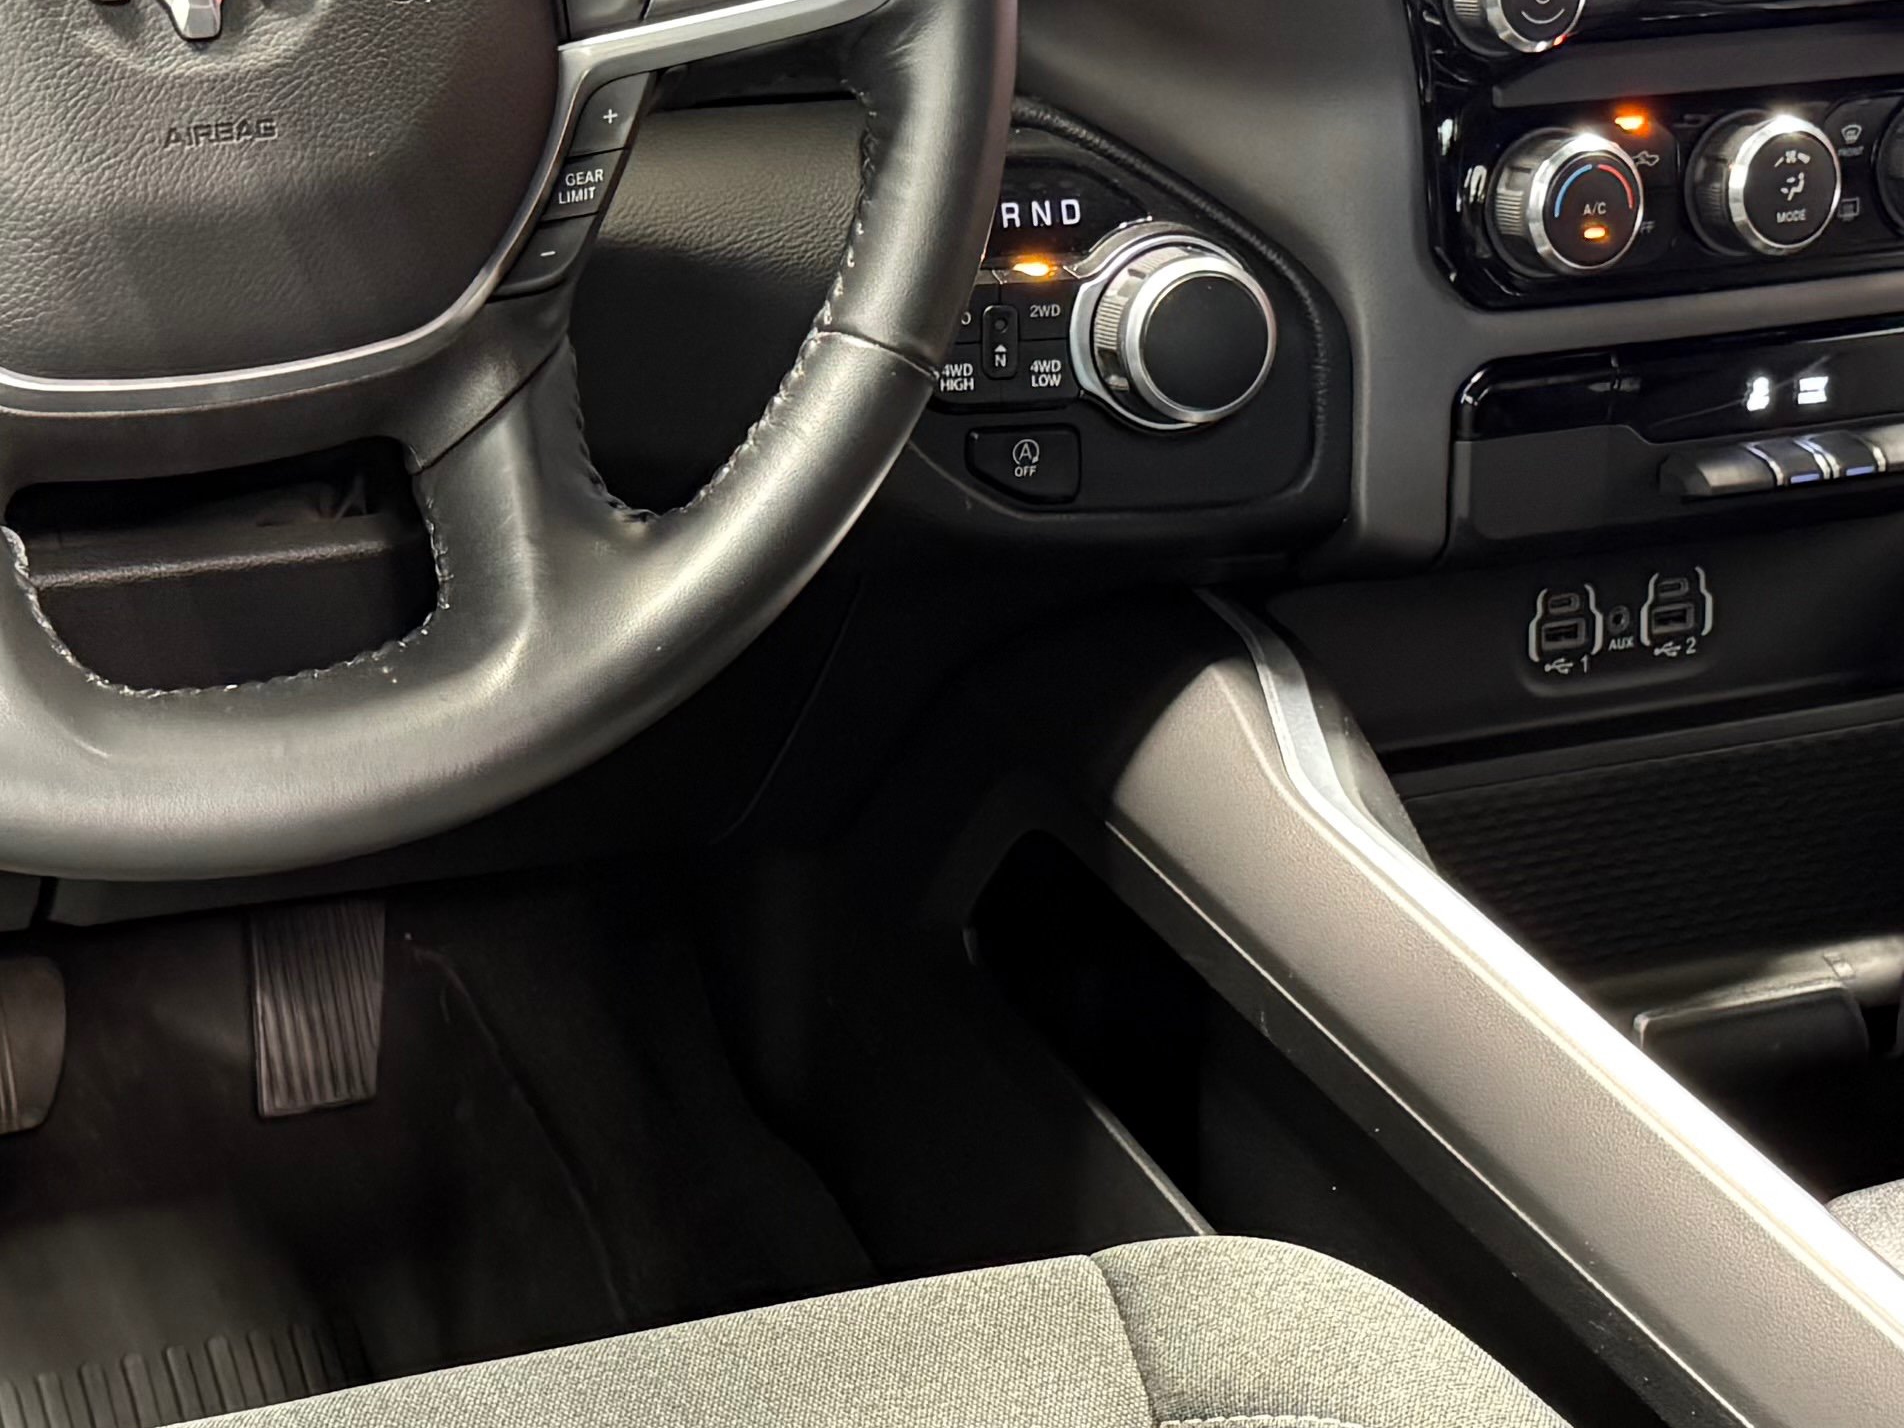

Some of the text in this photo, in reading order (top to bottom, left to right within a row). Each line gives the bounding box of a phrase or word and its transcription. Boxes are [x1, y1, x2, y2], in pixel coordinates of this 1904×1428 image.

[163, 118, 278, 149] AIRBAG
[565, 168, 604, 187] GEAR
[558, 186, 596, 205] LIMIT
[1001, 198, 1082, 229] R N D
[1583, 202, 1607, 216] A/C
[1776, 208, 1807, 223] MODE
[1029, 304, 1061, 318] 2WD
[994, 354, 1007, 368] N
[1030, 359, 1062, 373] 4WD
[942, 363, 974, 377] 4WD
[940, 378, 975, 392] HIGH
[1031, 374, 1062, 388] LOW
[1014, 466, 1037, 478] OFF
[1608, 636, 1635, 651] AUX
[1685, 637, 1697, 655] 2
[1580, 655, 1588, 673] 1
